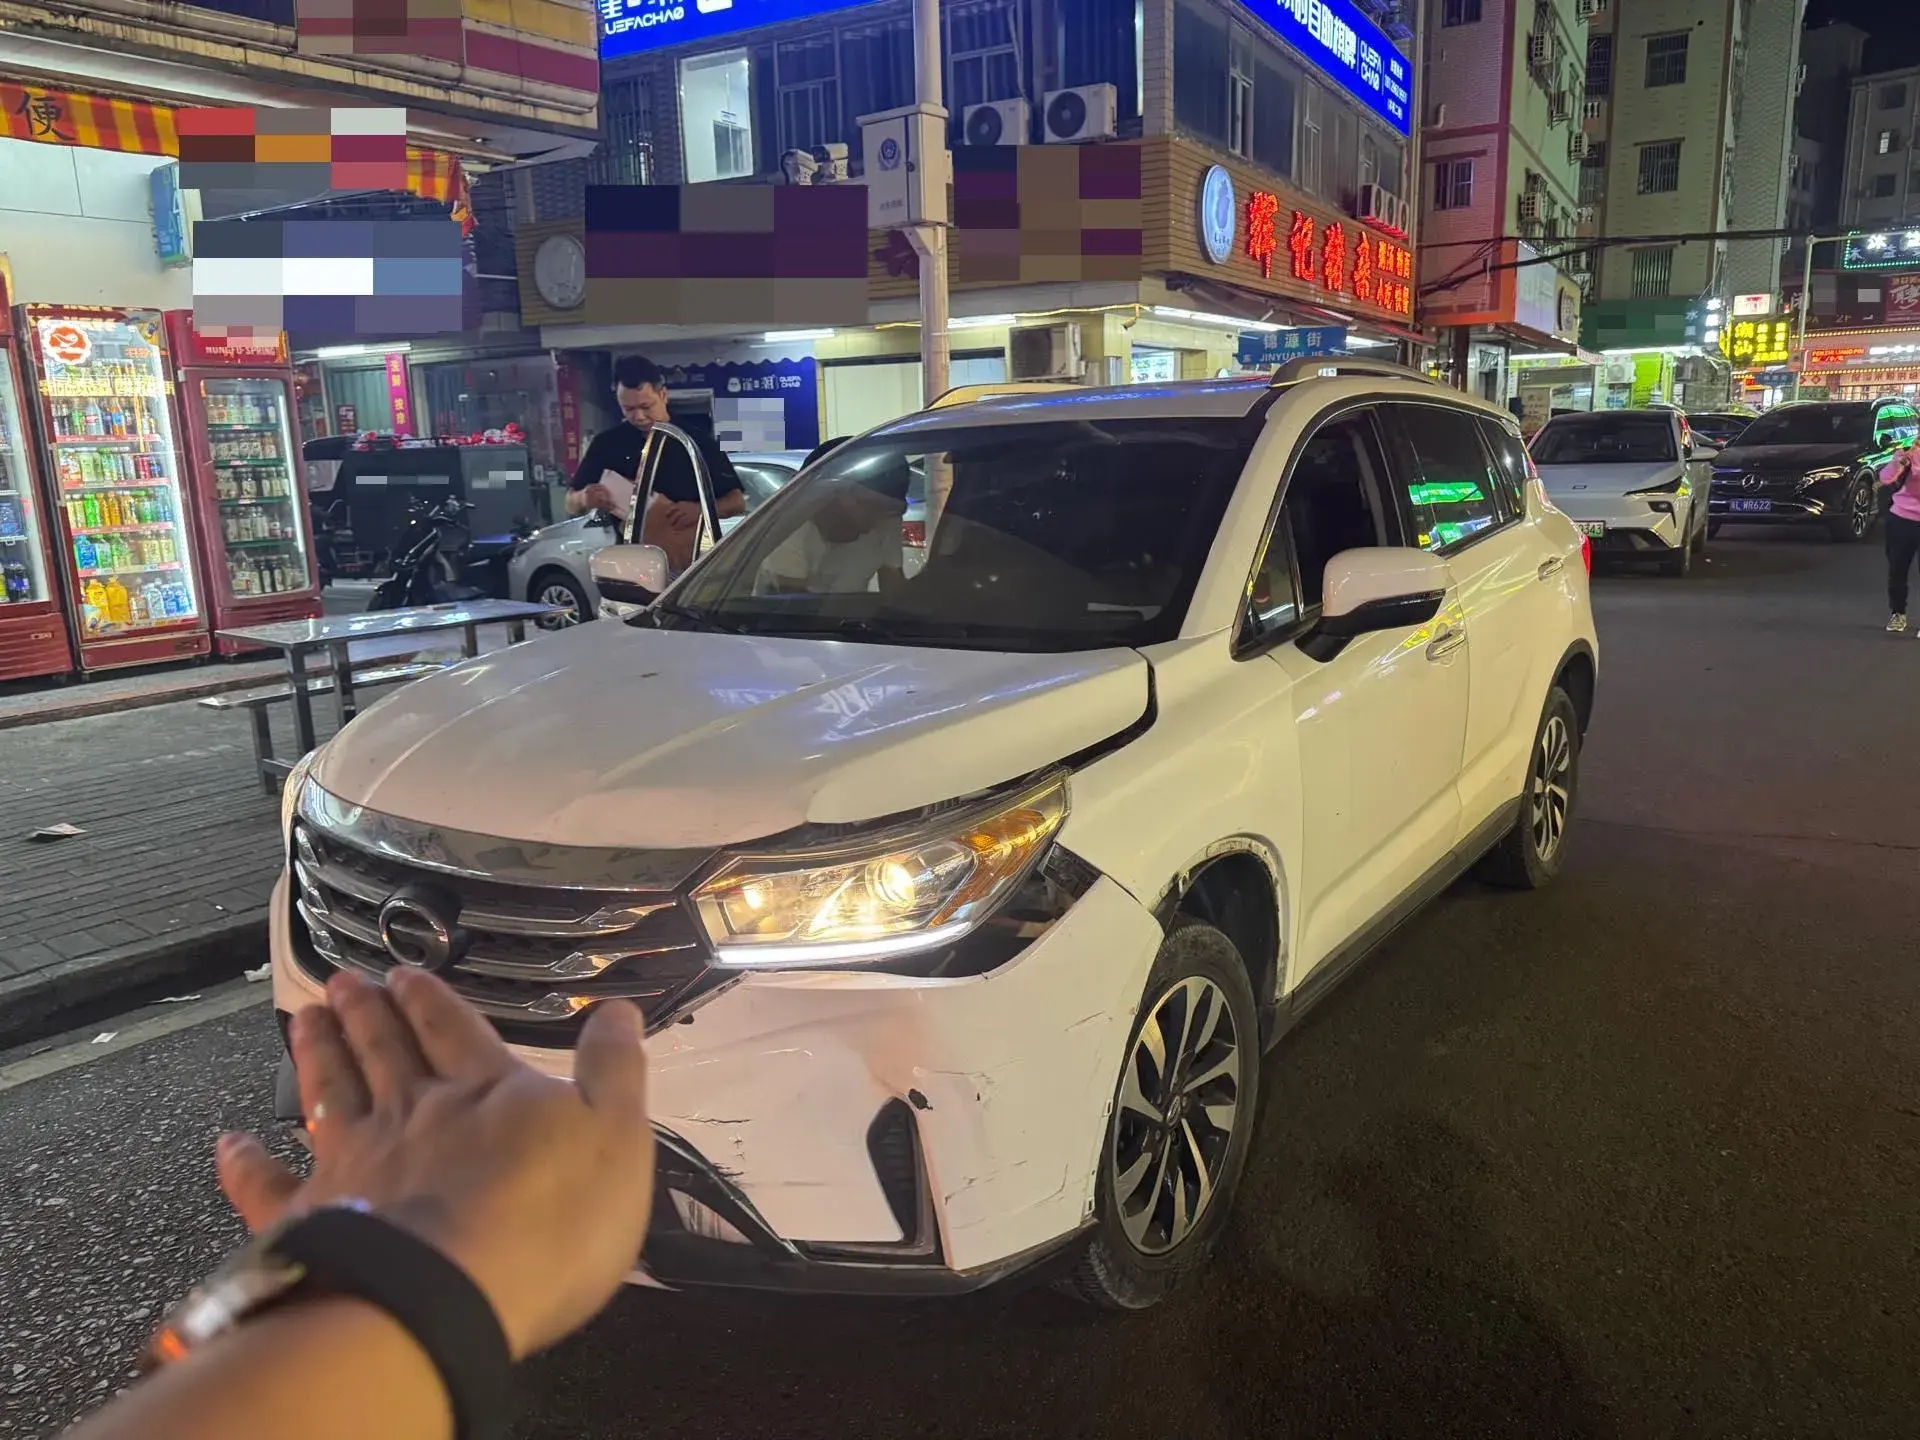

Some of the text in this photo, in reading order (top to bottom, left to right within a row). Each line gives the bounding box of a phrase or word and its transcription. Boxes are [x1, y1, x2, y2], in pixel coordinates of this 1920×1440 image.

[15, 91, 76, 141] 便
[1264, 332, 1321, 350] 锦源街
[1260, 351, 1304, 362] JINYUAN
